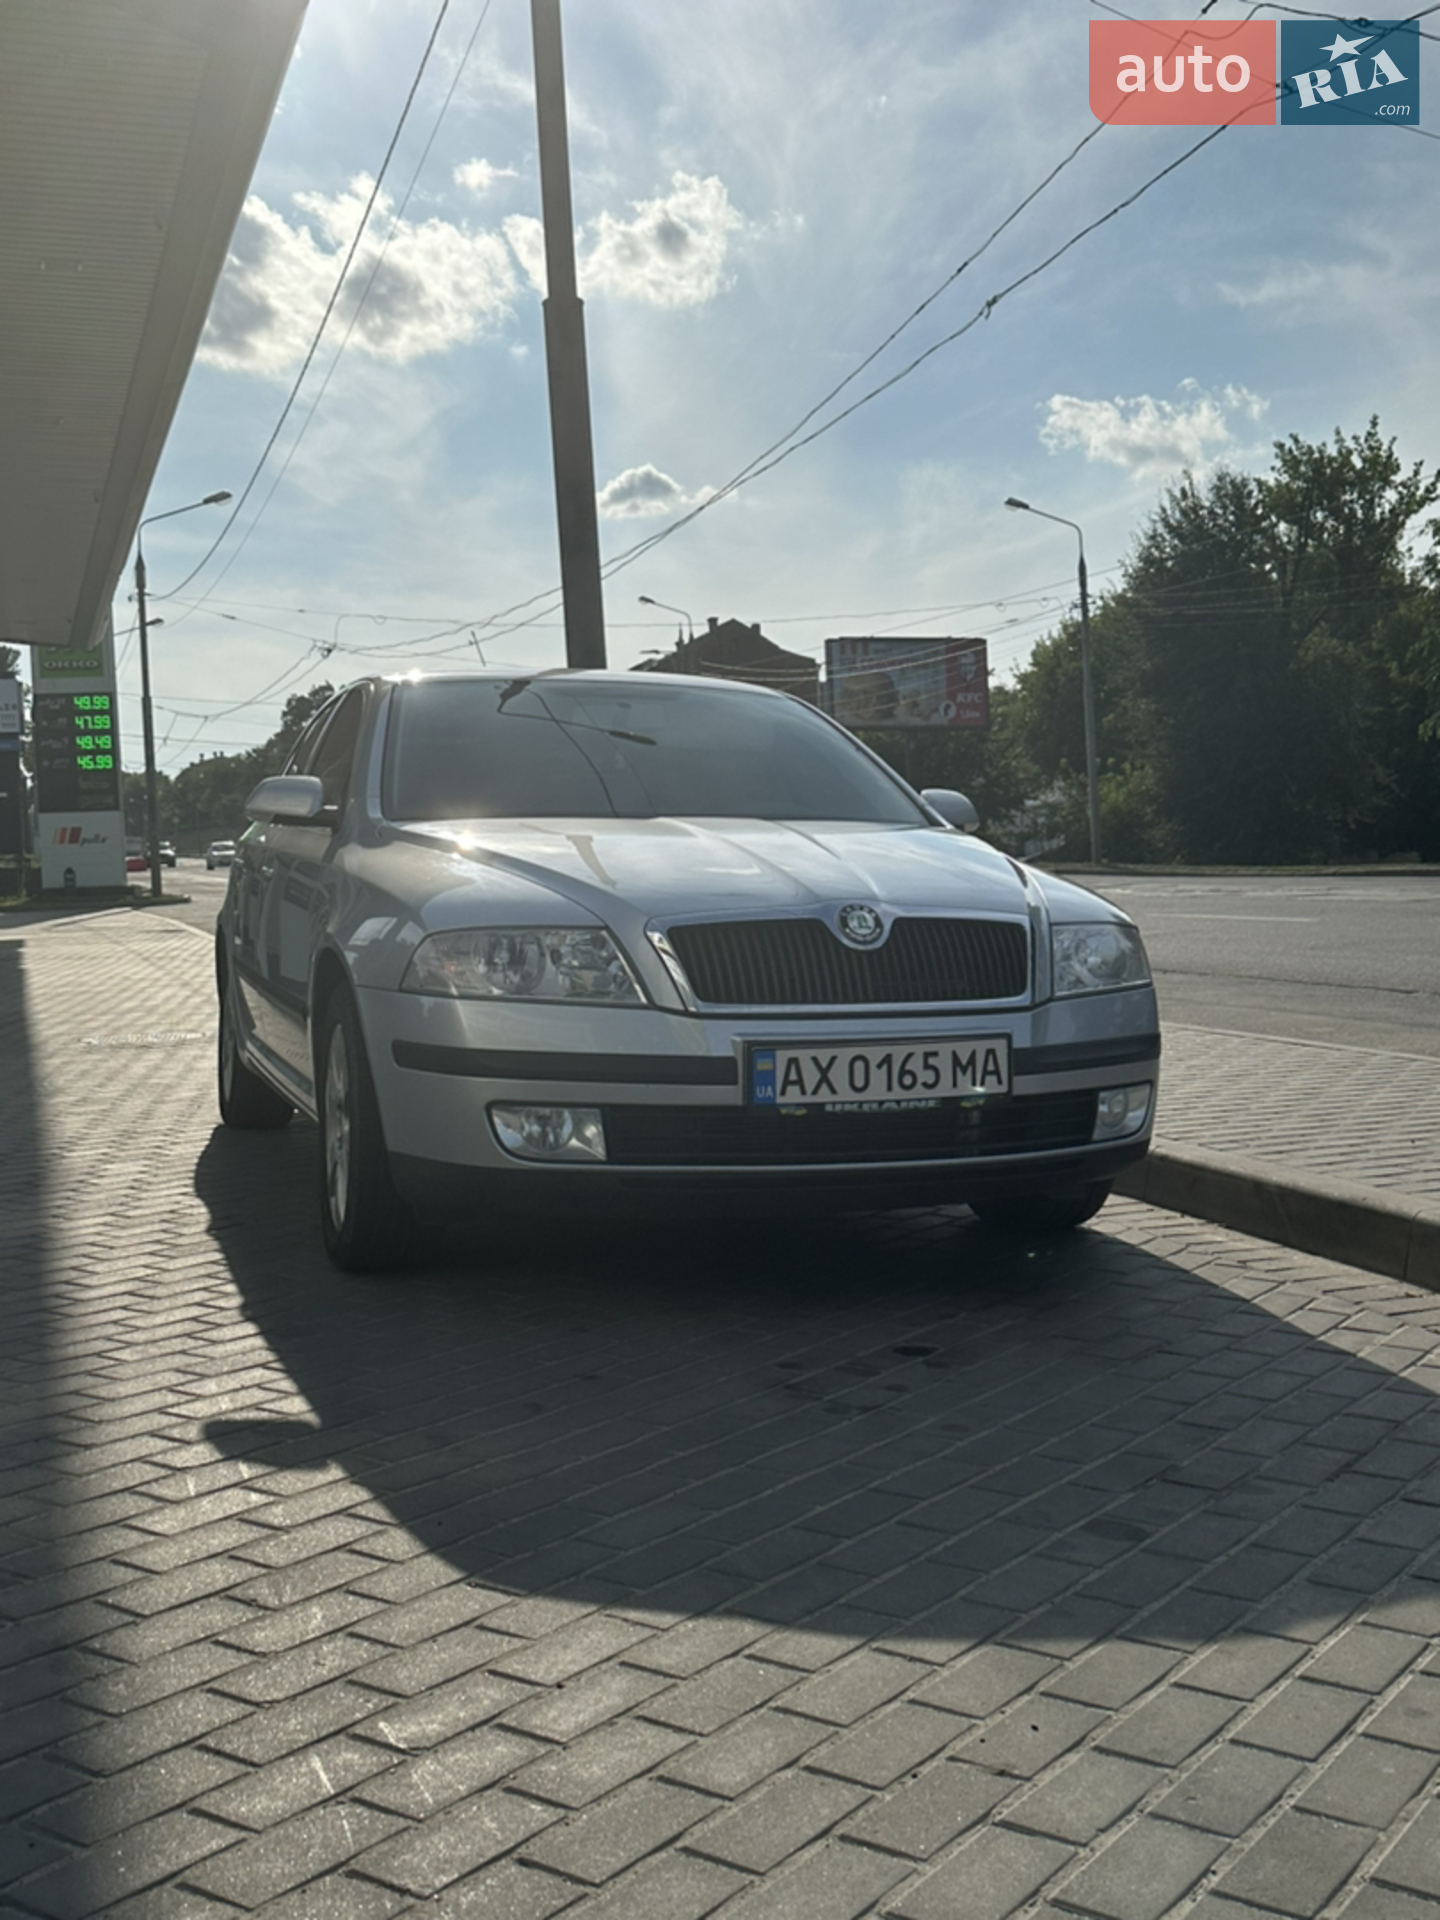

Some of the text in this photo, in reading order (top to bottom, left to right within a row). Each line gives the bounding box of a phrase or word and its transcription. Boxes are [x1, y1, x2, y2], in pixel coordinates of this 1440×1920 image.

[44, 659, 98, 670] OKKO
[74, 695, 110, 710] 49.99
[956, 692, 984, 703] KFC
[75, 715, 111, 730] 47.99
[76, 735, 112, 750] 49.49
[77, 755, 114, 770] 45.99
[779, 1048, 1003, 1097] AX 0165 MA
[756, 1085, 774, 1098] UA
[824, 1099, 941, 1113] UKRAINE
